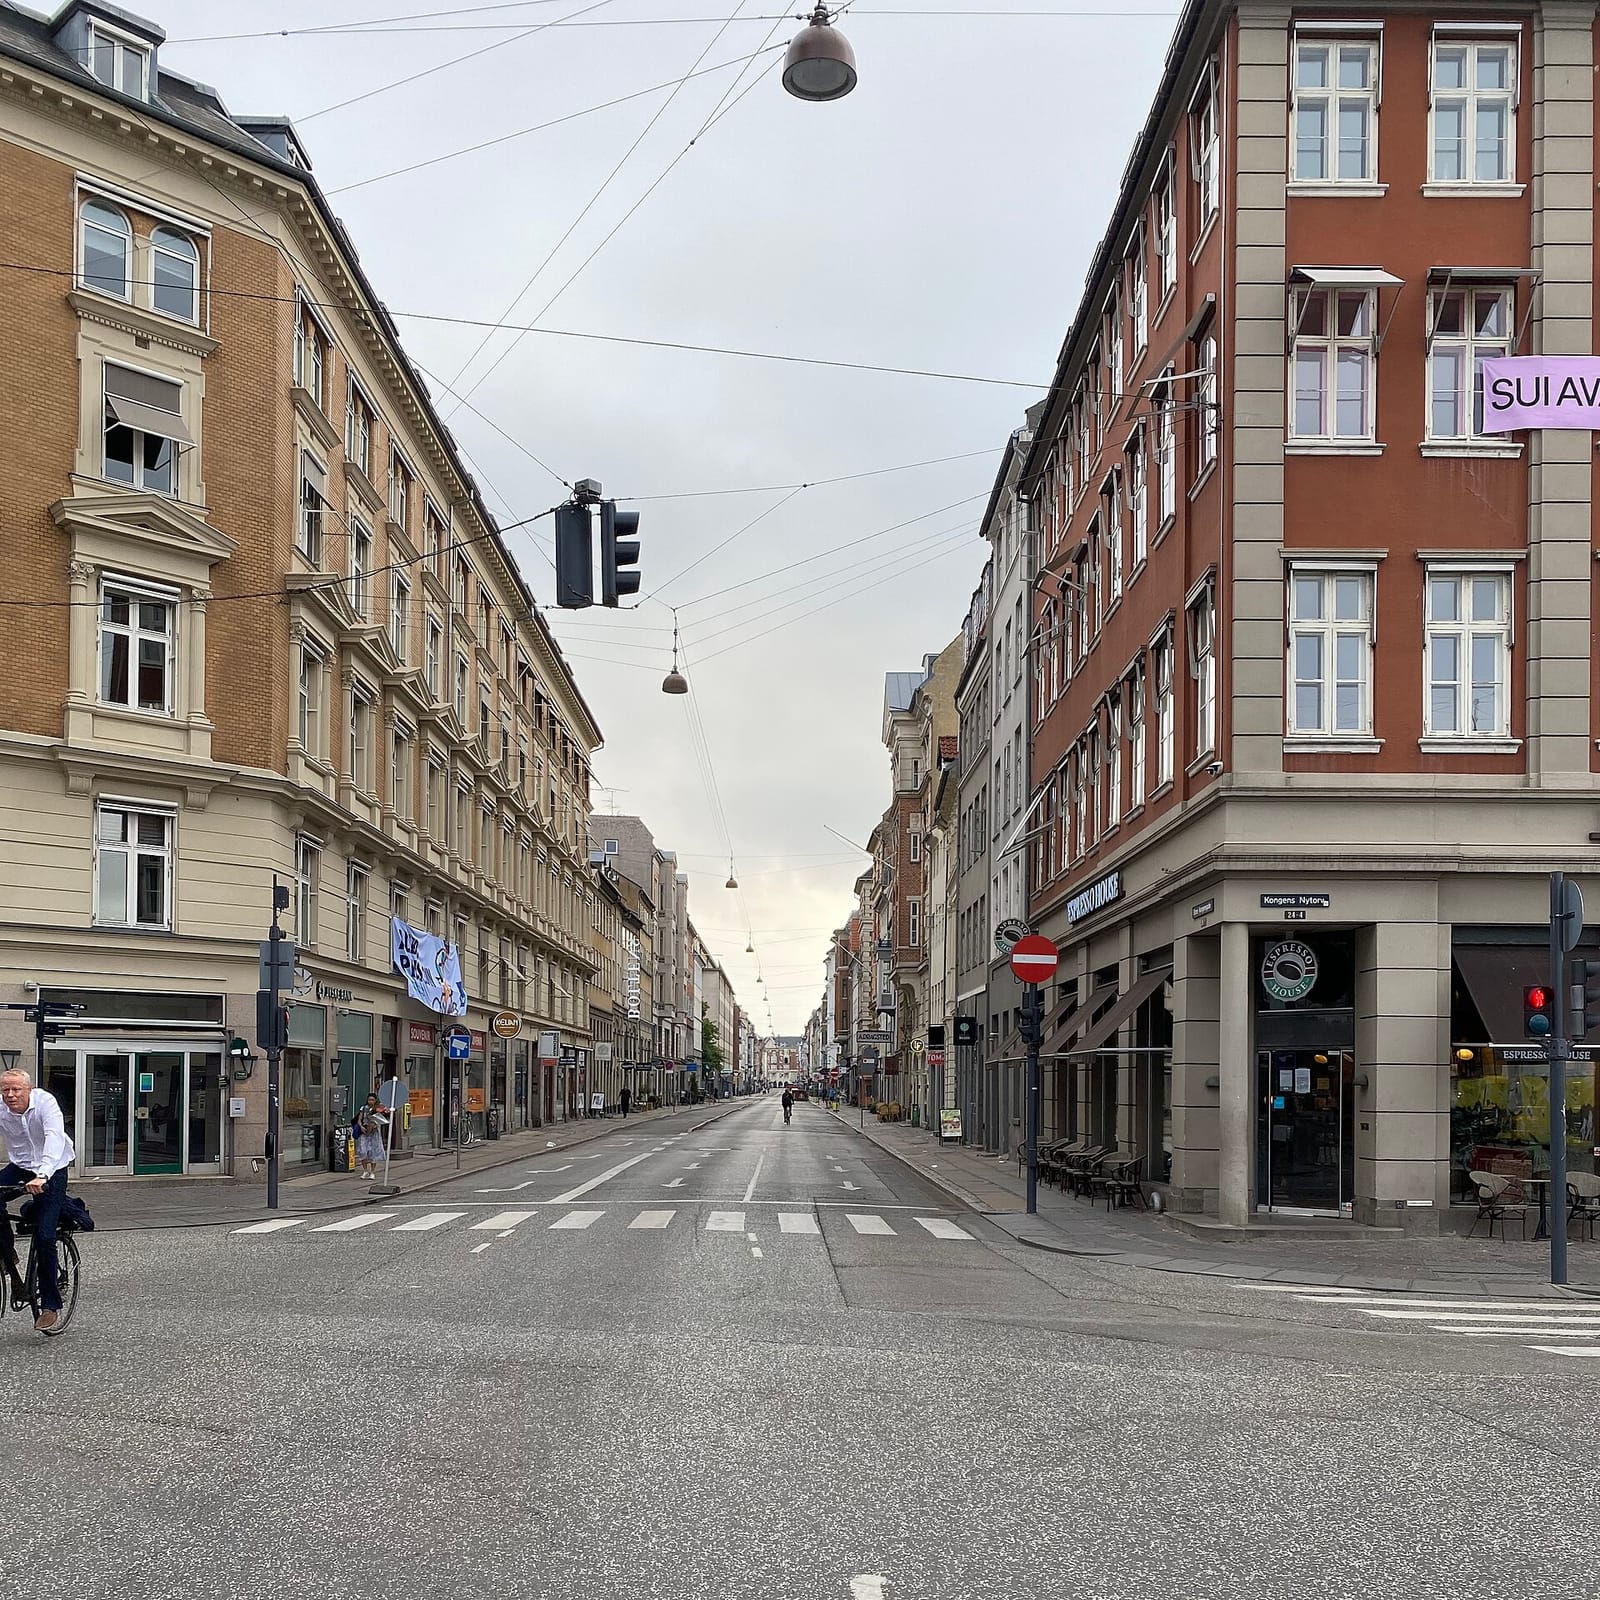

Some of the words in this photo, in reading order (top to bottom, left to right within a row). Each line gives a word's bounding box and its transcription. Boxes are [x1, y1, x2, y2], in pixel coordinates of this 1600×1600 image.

[1491, 376, 1549, 410] SUI
[1556, 376, 1600, 407] AV
[1095, 872, 1119, 909] HOUSE
[1264, 896, 1296, 905] Kongens
[1299, 896, 1325, 905] Nytorv
[1266, 944, 1313, 967] ESPRESSO
[1271, 981, 1308, 997] HOUSE
[1568, 1051, 1591, 1060] USE
